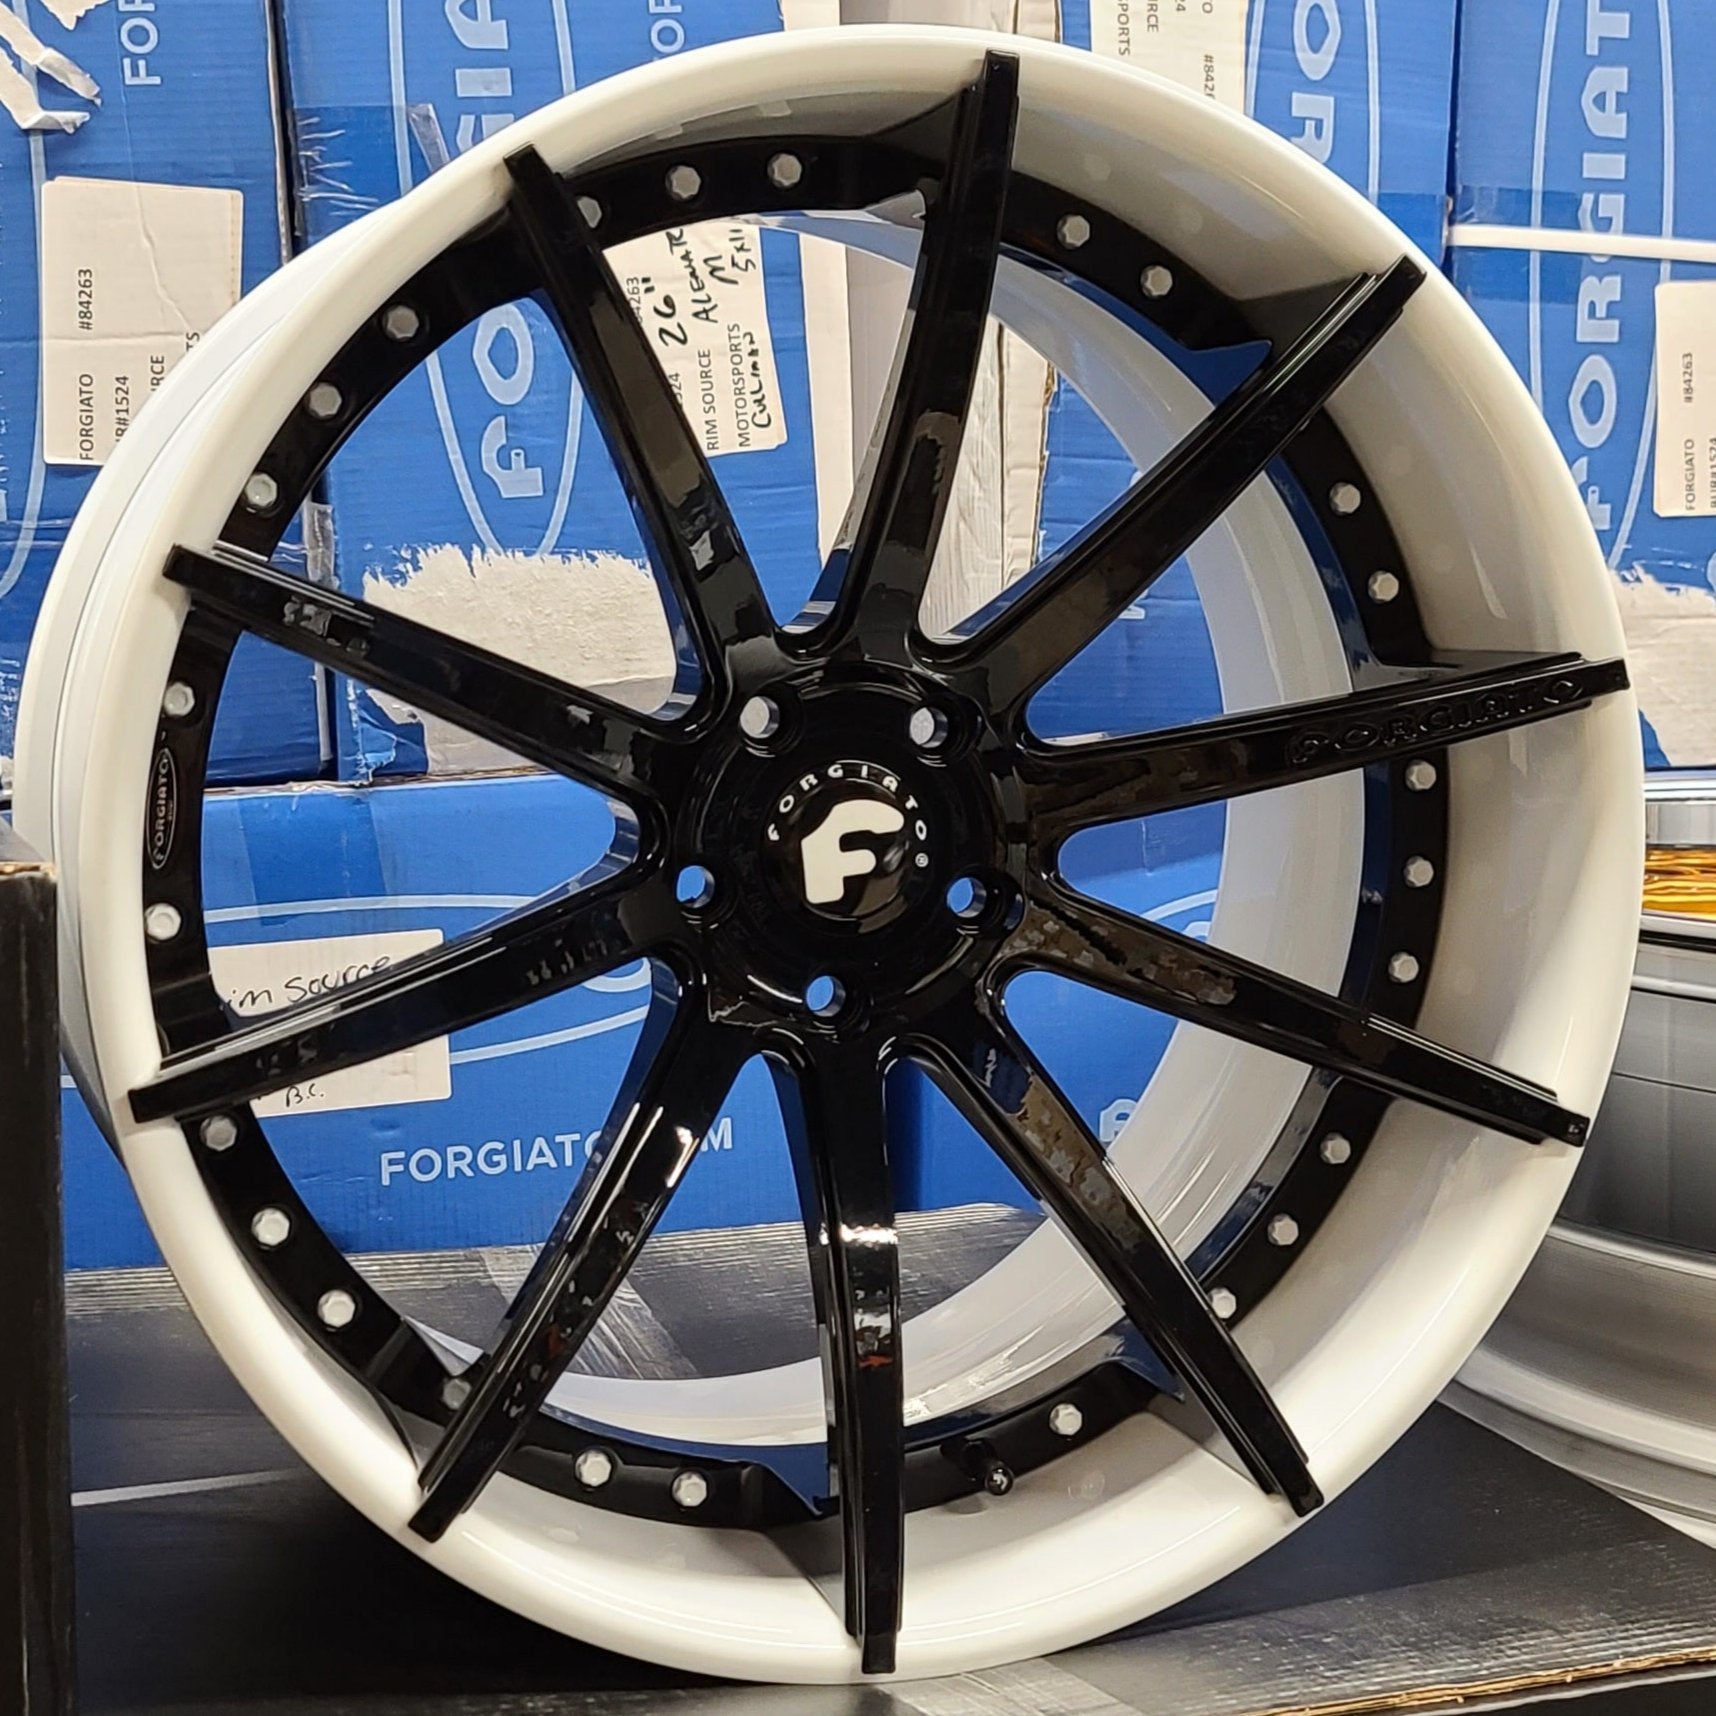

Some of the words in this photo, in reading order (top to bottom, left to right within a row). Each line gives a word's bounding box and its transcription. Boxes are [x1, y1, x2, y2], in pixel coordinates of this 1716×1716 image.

[1147, 0, 1159, 32] RCE
[78, 268, 93, 330] #84263
[150, 355, 165, 391] RCE
[698, 349, 716, 414] SOURCE
[727, 323, 751, 447] MOTORSPORTS
[79, 374, 94, 460] FORGIATO
[115, 375, 129, 442] R#1524
[707, 419, 719, 450] RIM
[1684, 438, 1695, 511] FORGIATO
[153, 756, 169, 861] FORGIATO
[767, 764, 928, 841] FORGIATO
